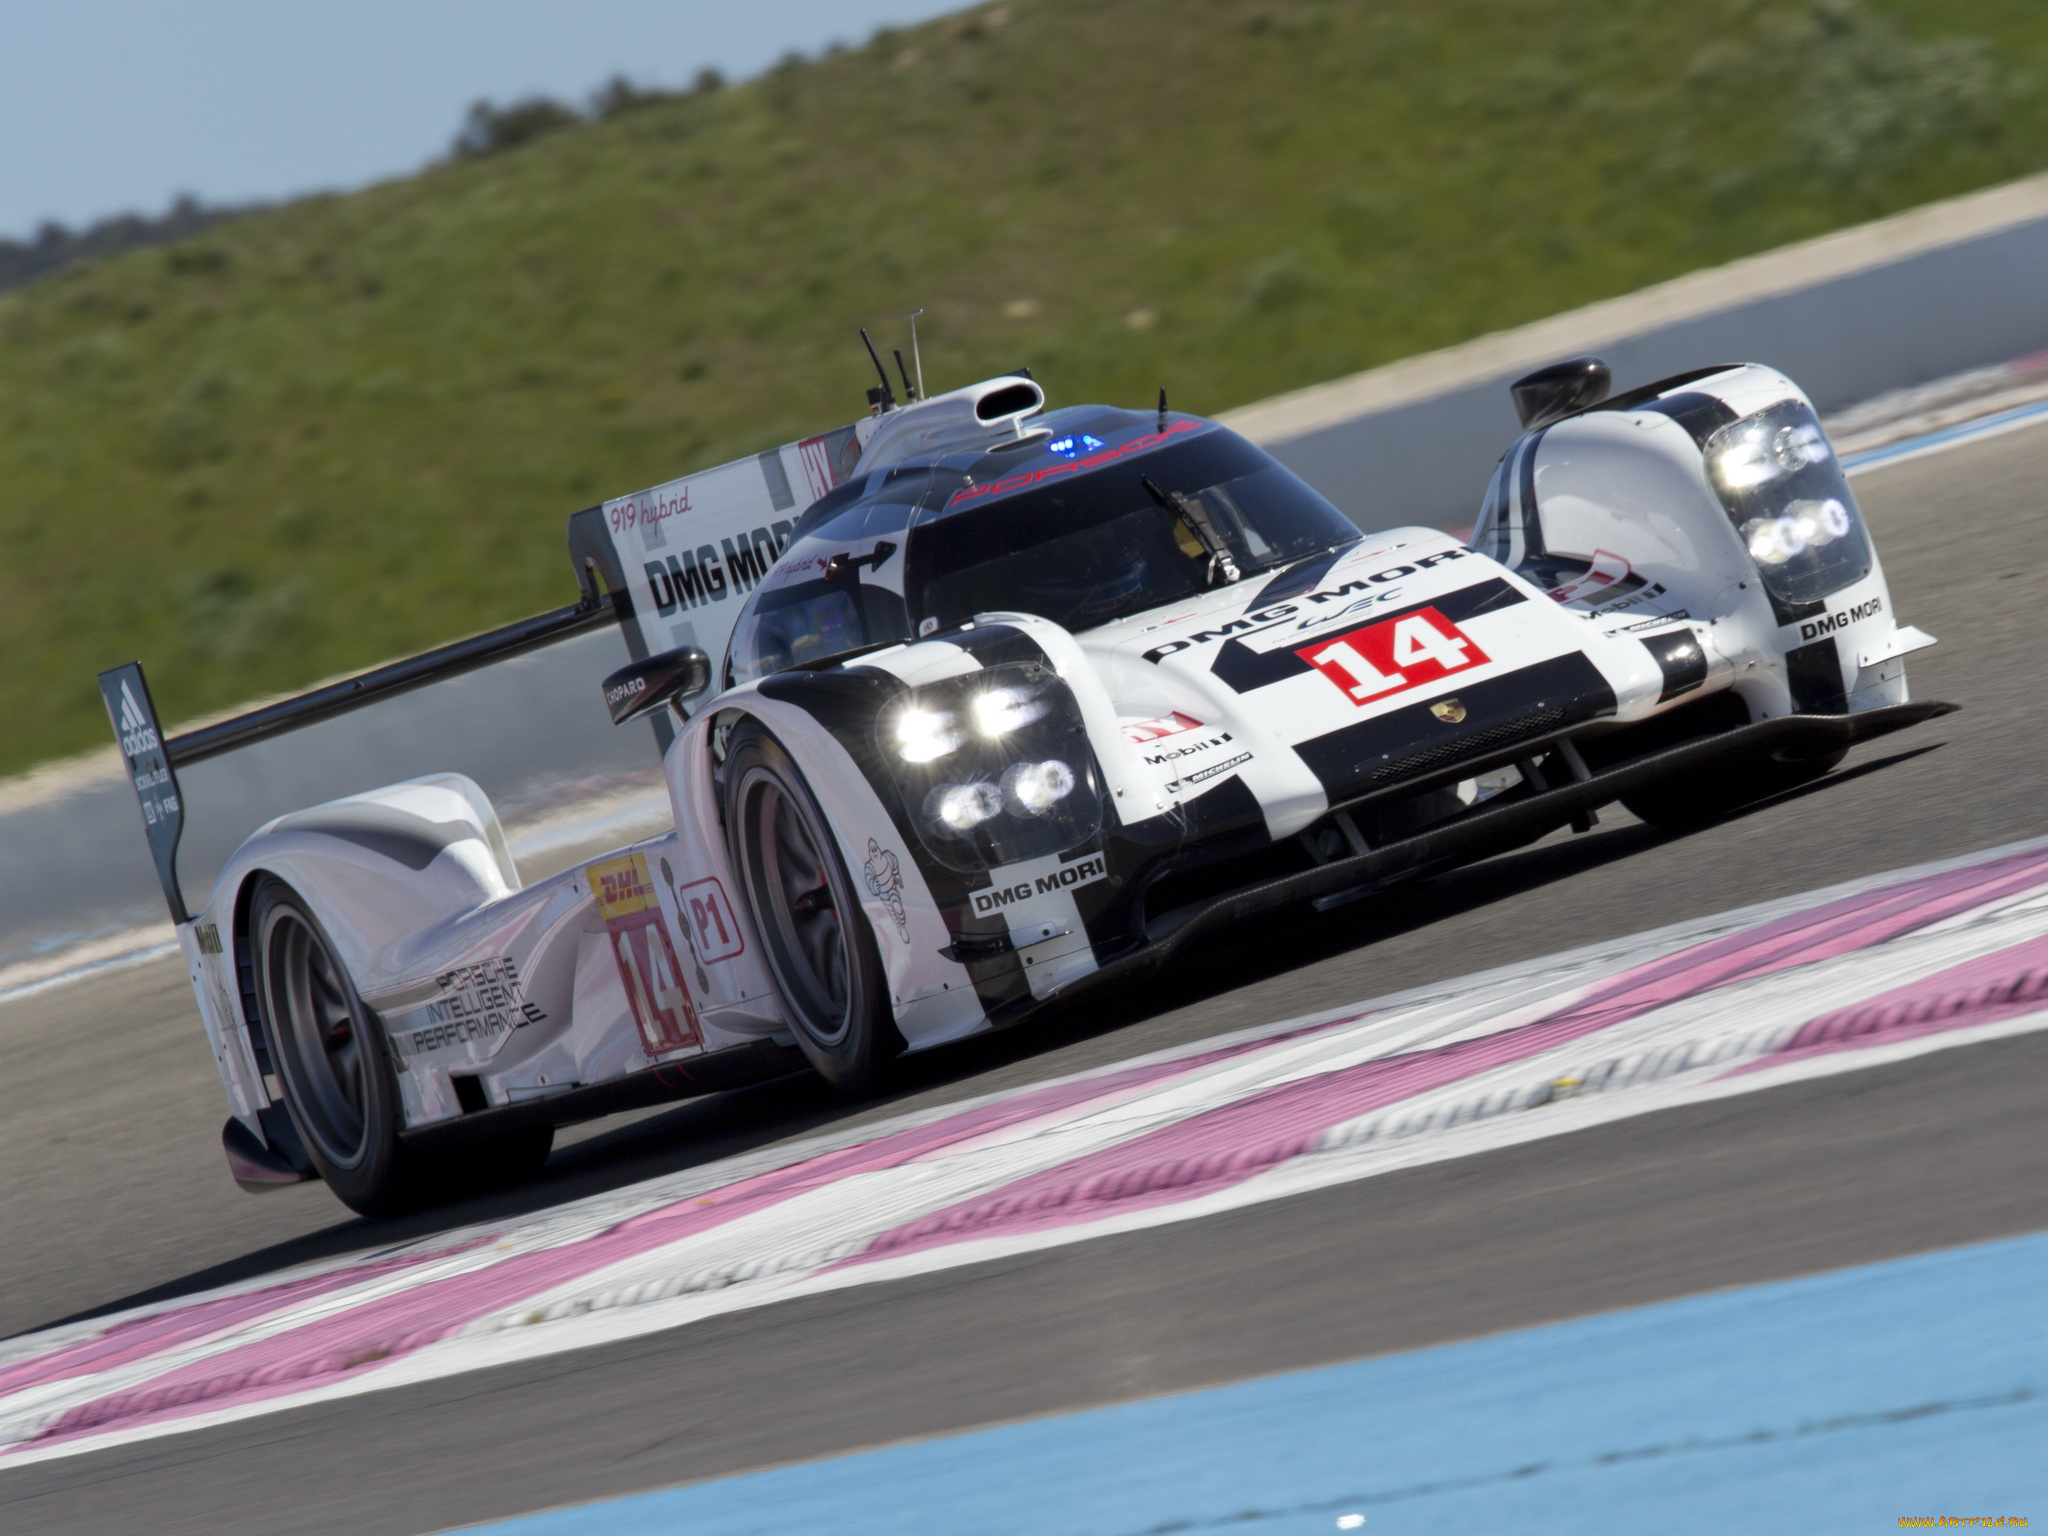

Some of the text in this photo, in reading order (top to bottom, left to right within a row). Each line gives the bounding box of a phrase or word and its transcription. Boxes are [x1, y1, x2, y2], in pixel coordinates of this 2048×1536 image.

[950, 420, 1203, 506] PORSCHE
[610, 486, 692, 538] 919 hybrid
[643, 543, 727, 618] DMG
[1142, 604, 1299, 664] DMG
[1801, 596, 1883, 641] DMG MORI
[1312, 615, 1470, 700] 14
[606, 677, 647, 705] CHOPARD
[123, 726, 157, 757] adidas
[1144, 741, 1209, 765] Mobil
[1192, 752, 1250, 783] MICHELIN
[163, 796, 178, 814] FAG
[600, 868, 647, 904] DHL
[975, 858, 1106, 912] DMG MORI
[690, 893, 731, 951] P1
[436, 956, 518, 995] PORSCHE
[617, 922, 690, 1045] 14
[426, 981, 525, 1023] INTELLIGENT
[413, 1002, 548, 1053] PERFORMANCE
